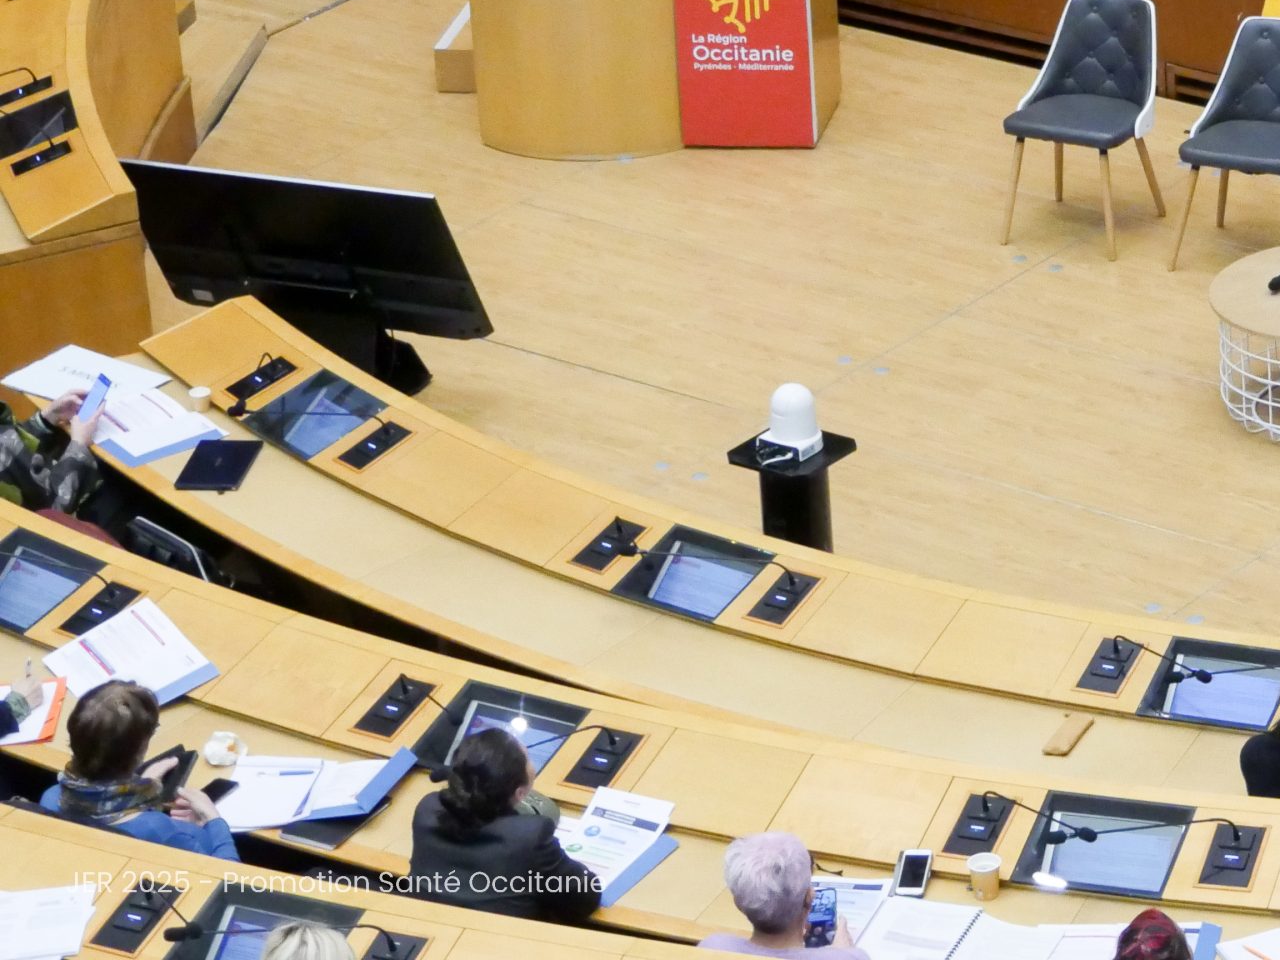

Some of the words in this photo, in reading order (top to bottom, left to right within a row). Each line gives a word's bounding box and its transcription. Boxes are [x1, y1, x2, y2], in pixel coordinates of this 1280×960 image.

[691, 33, 705, 44] La
[707, 33, 747, 45] Région
[693, 45, 794, 61] Occitanie
[693, 62, 732, 71] Pyrénées
[738, 62, 794, 71] Méditerranée
